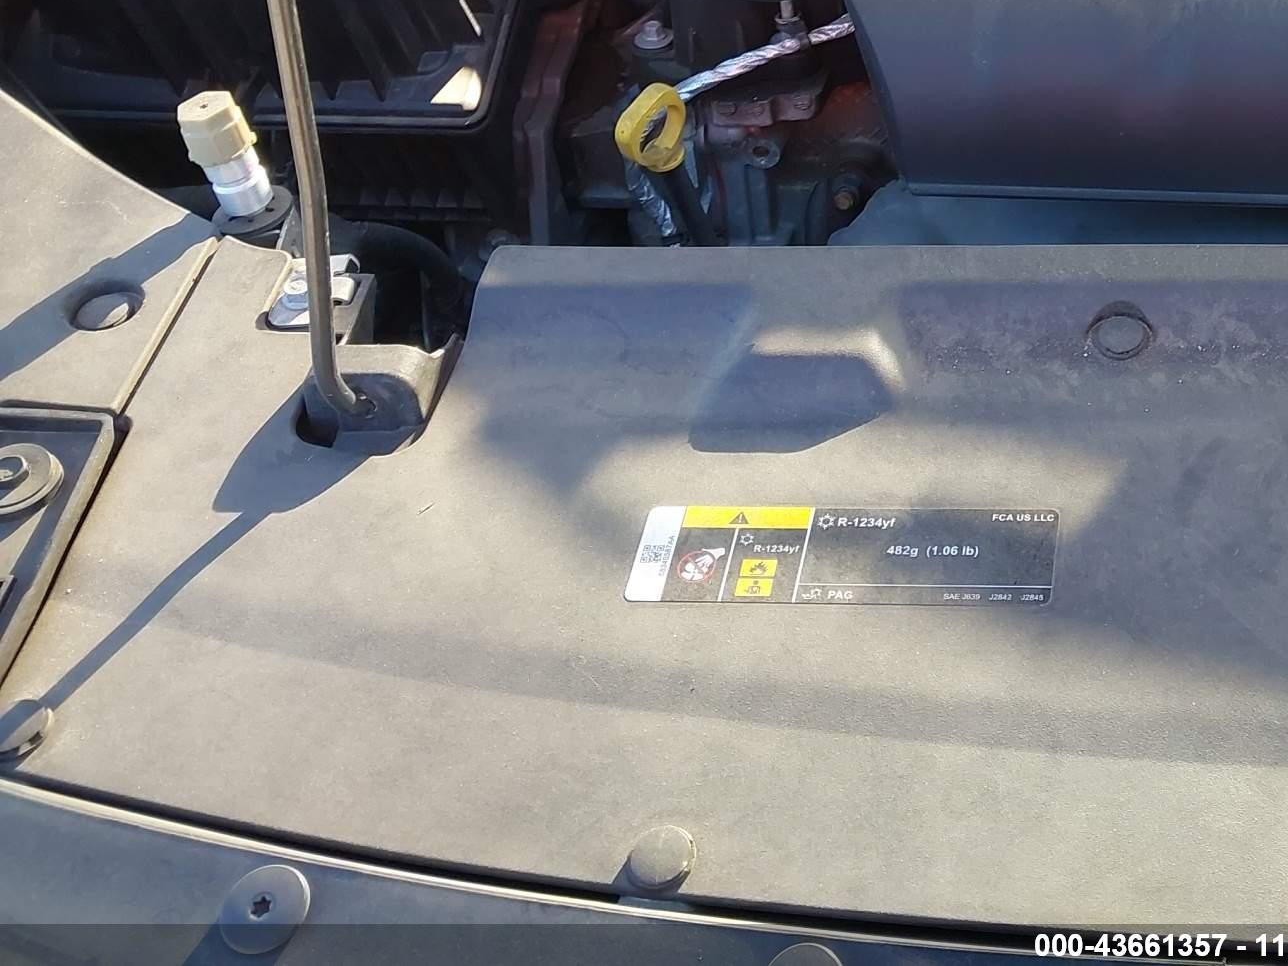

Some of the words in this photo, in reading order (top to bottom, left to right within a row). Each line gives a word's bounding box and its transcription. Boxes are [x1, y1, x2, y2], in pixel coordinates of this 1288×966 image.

[991, 513, 1014, 522] FCA
[1016, 513, 1031, 522] US
[1033, 513, 1055, 522] LLC
[837, 517, 896, 530] R-1234yf
[753, 544, 800, 555] R-1234yf
[886, 545, 919, 558] 482g
[926, 545, 959, 558] (1.06
[962, 545, 979, 558] lb)
[827, 590, 854, 600] PAG
[943, 593, 960, 601] SAE
[962, 593, 980, 601] J639
